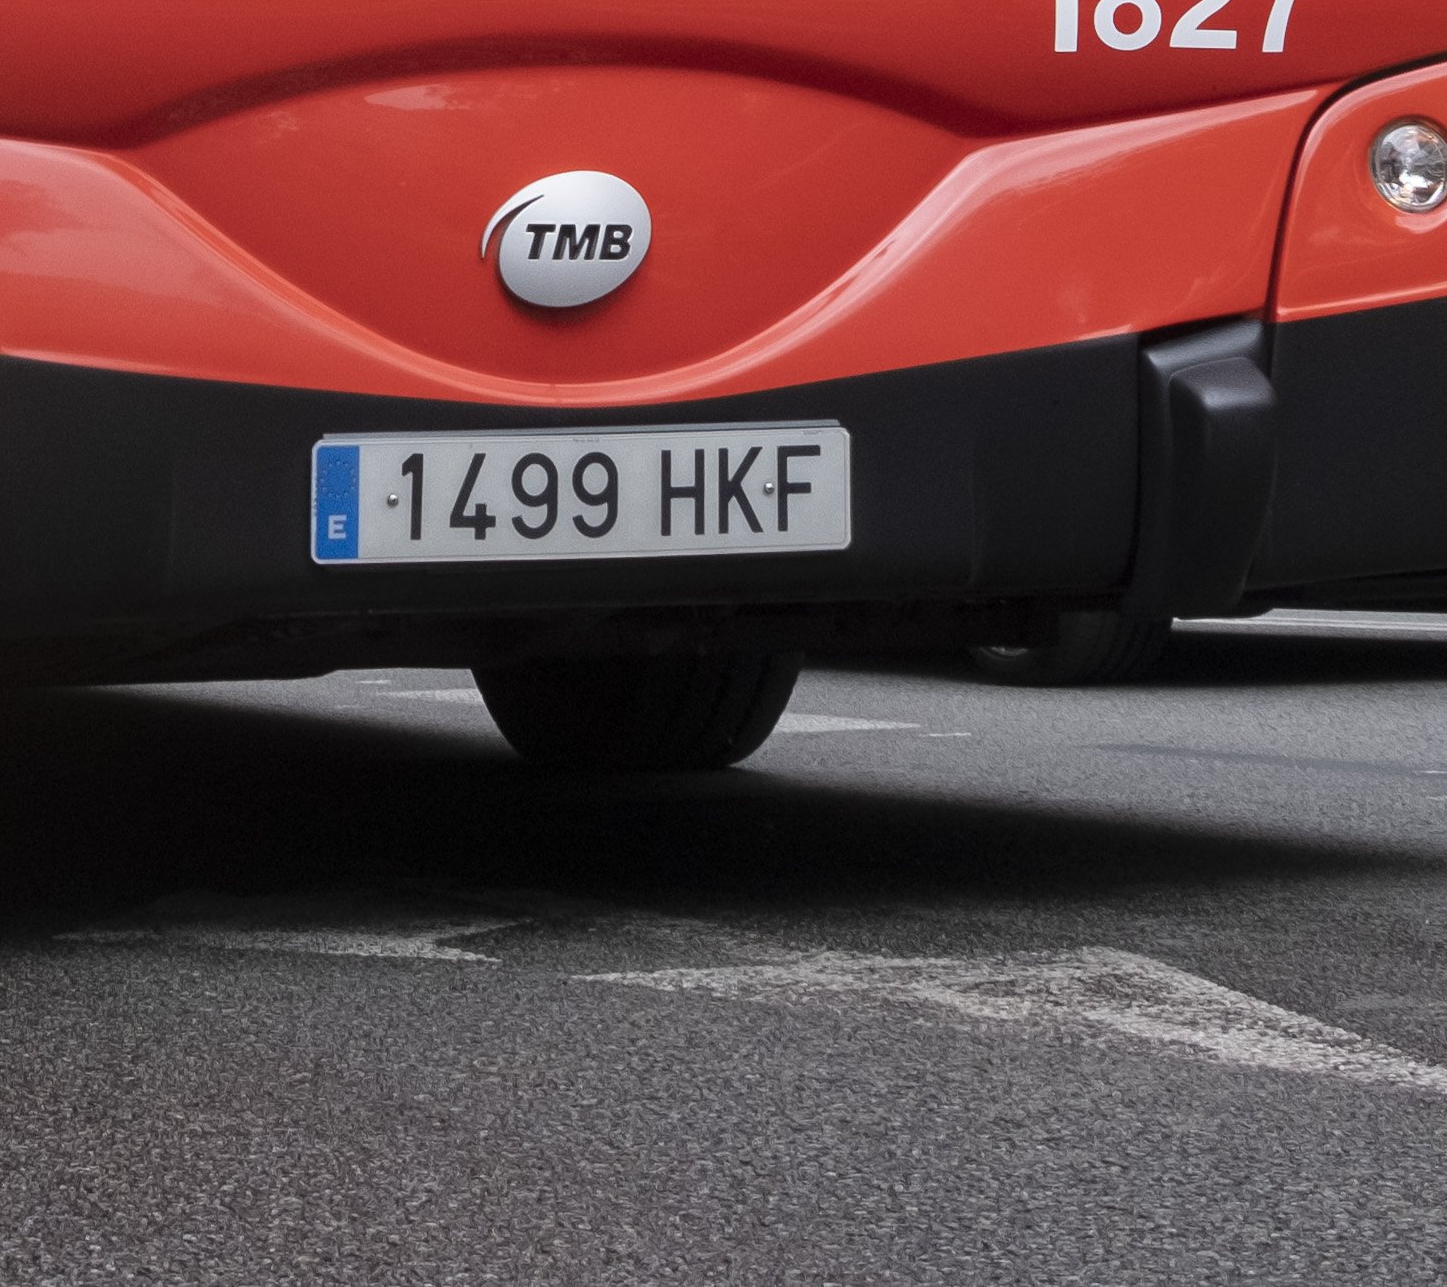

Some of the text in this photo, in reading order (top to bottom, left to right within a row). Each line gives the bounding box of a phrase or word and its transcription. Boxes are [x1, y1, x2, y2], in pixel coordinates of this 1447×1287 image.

[525, 223, 634, 261] TMB
[327, 444, 821, 541] E 1499 HKF
